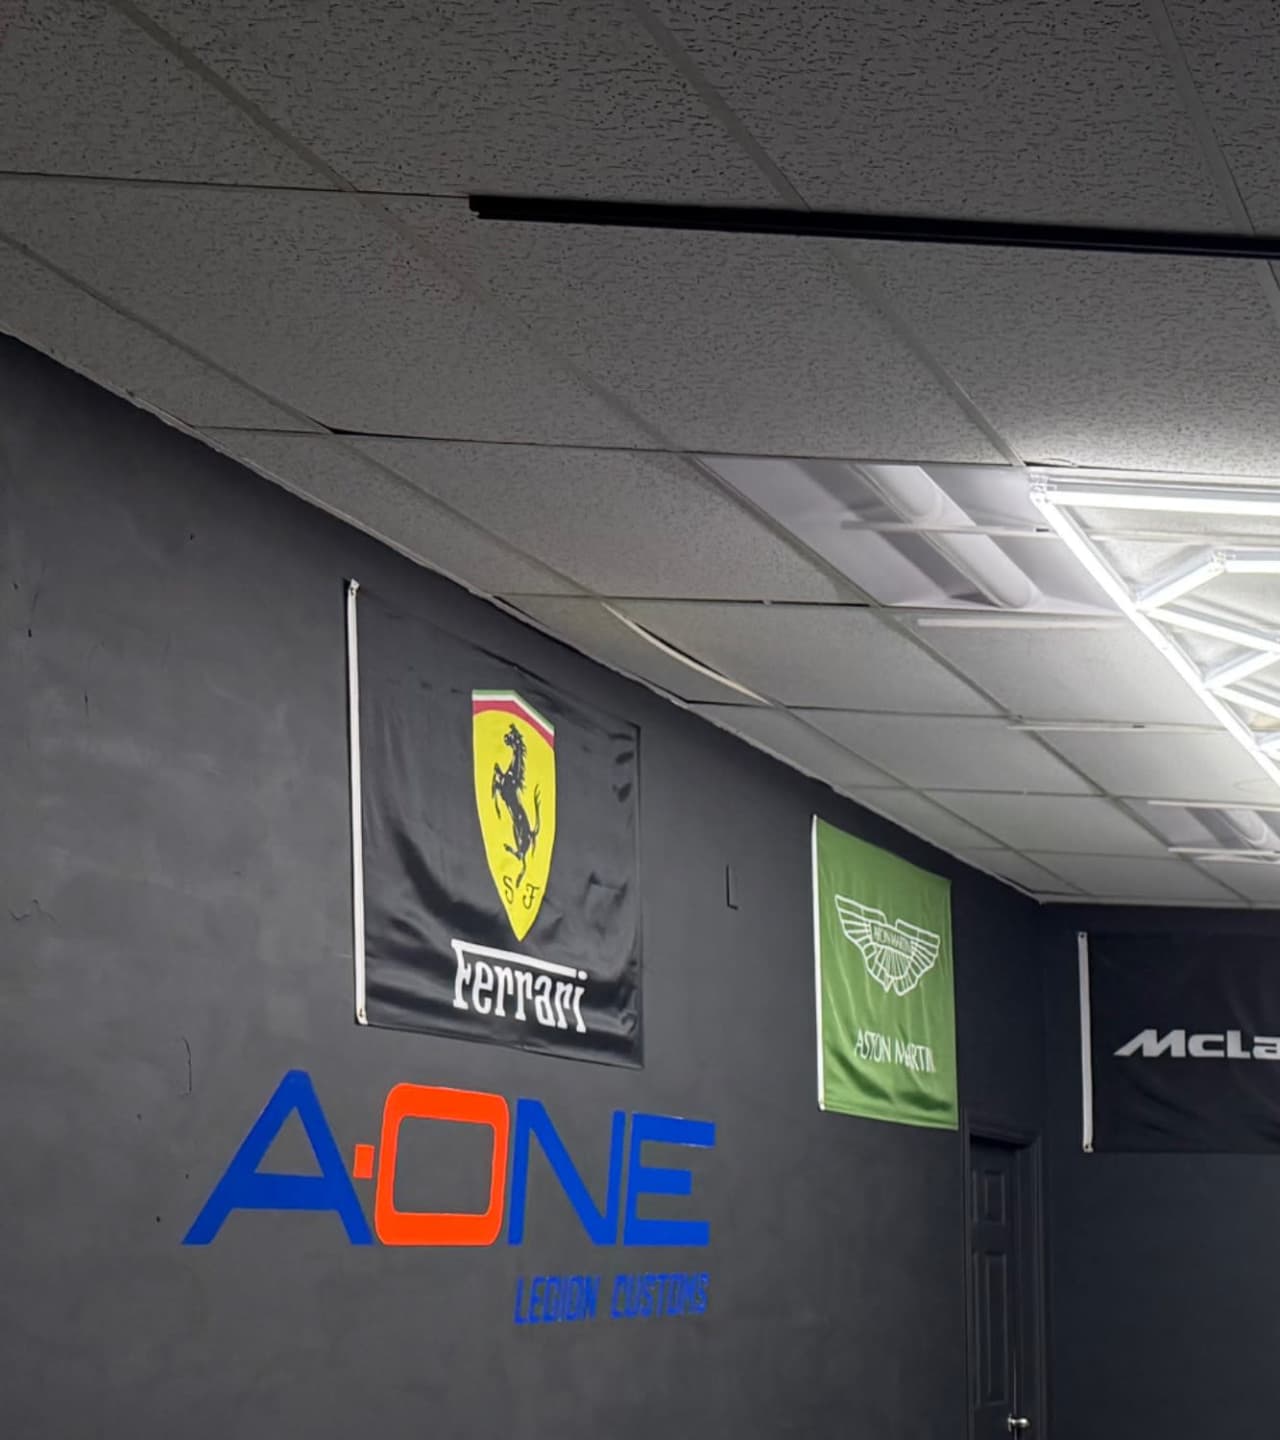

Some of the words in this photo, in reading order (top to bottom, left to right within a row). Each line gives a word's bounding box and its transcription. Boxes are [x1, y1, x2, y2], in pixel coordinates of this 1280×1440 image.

[451, 938, 588, 1033] Ferrari
[854, 1028, 892, 1064] ASTON
[610, 1271, 710, 1320] CUSTOMS
